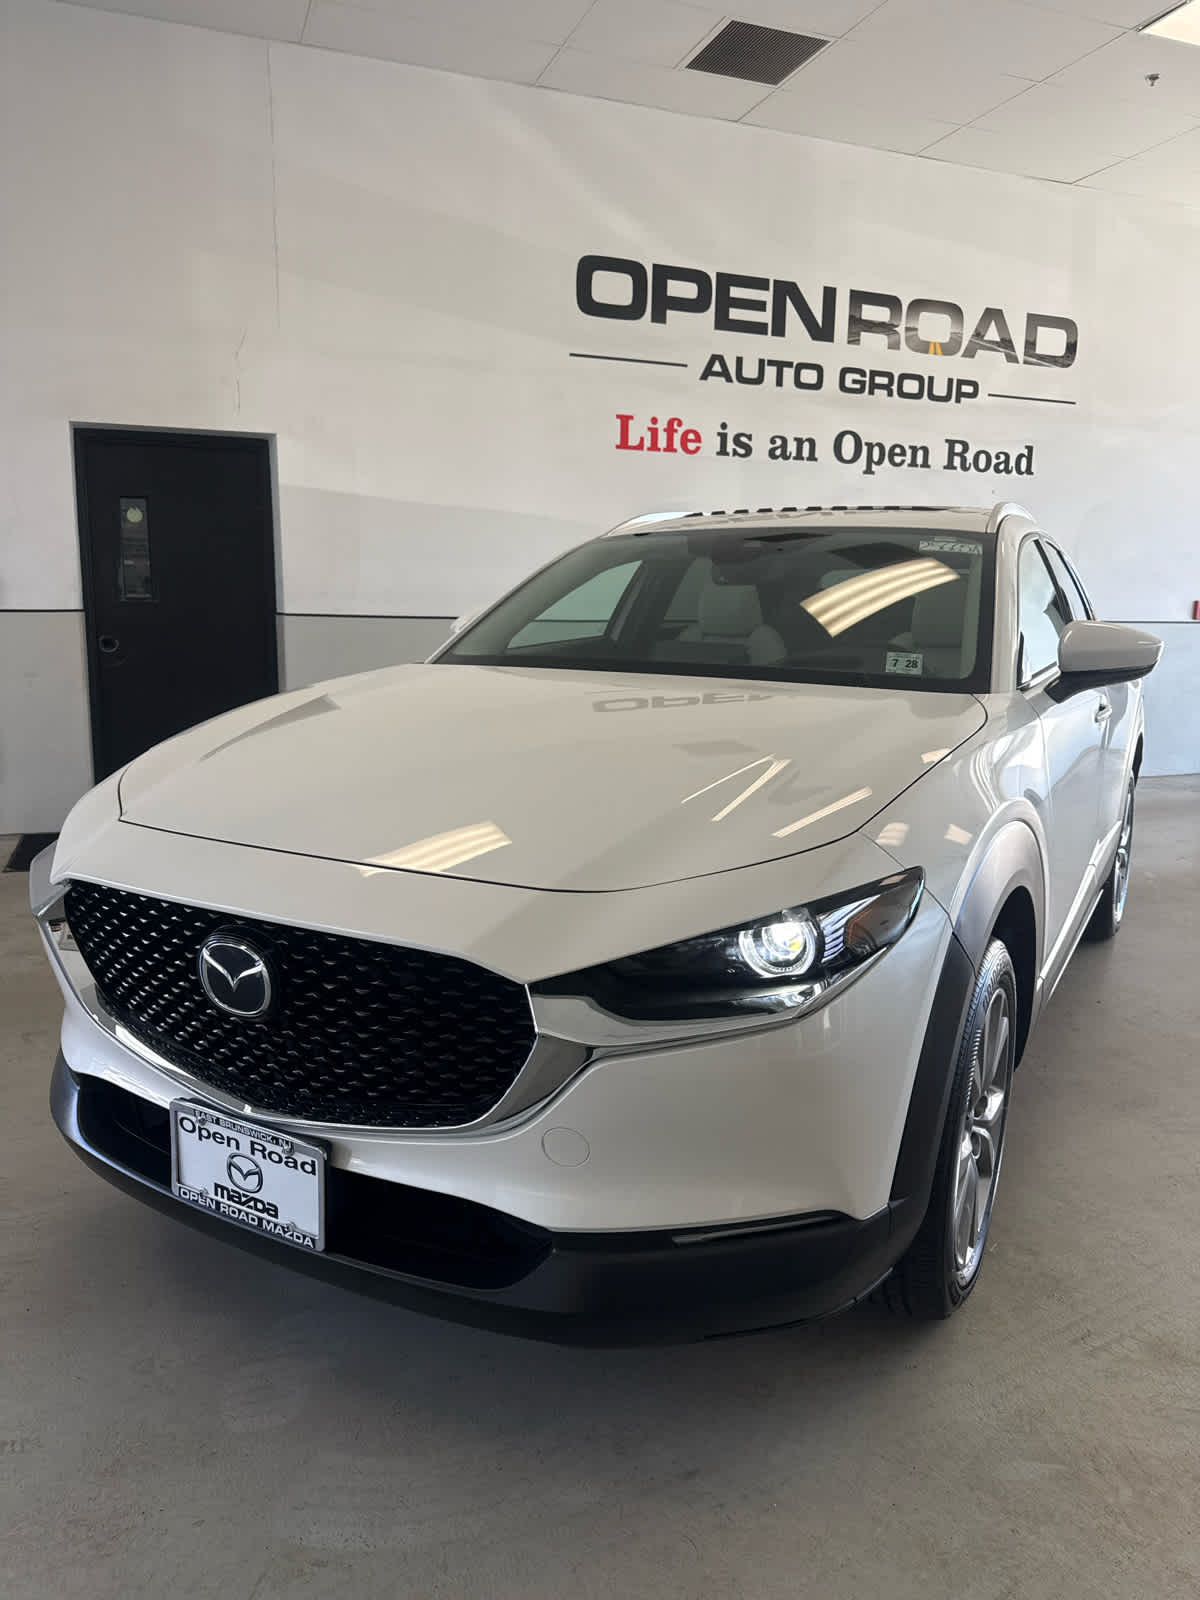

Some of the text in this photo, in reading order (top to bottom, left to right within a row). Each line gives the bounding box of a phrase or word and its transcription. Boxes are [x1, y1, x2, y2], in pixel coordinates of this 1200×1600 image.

[699, 354, 980, 404] AUTO GROUP
[615, 413, 1035, 476] Life is an Open Road
[891, 659, 918, 668] 7 28
[194, 1109, 217, 1124] EAST
[179, 1116, 316, 1176] Open Road
[180, 1188, 314, 1249] OPEN ROAD MAZDA
